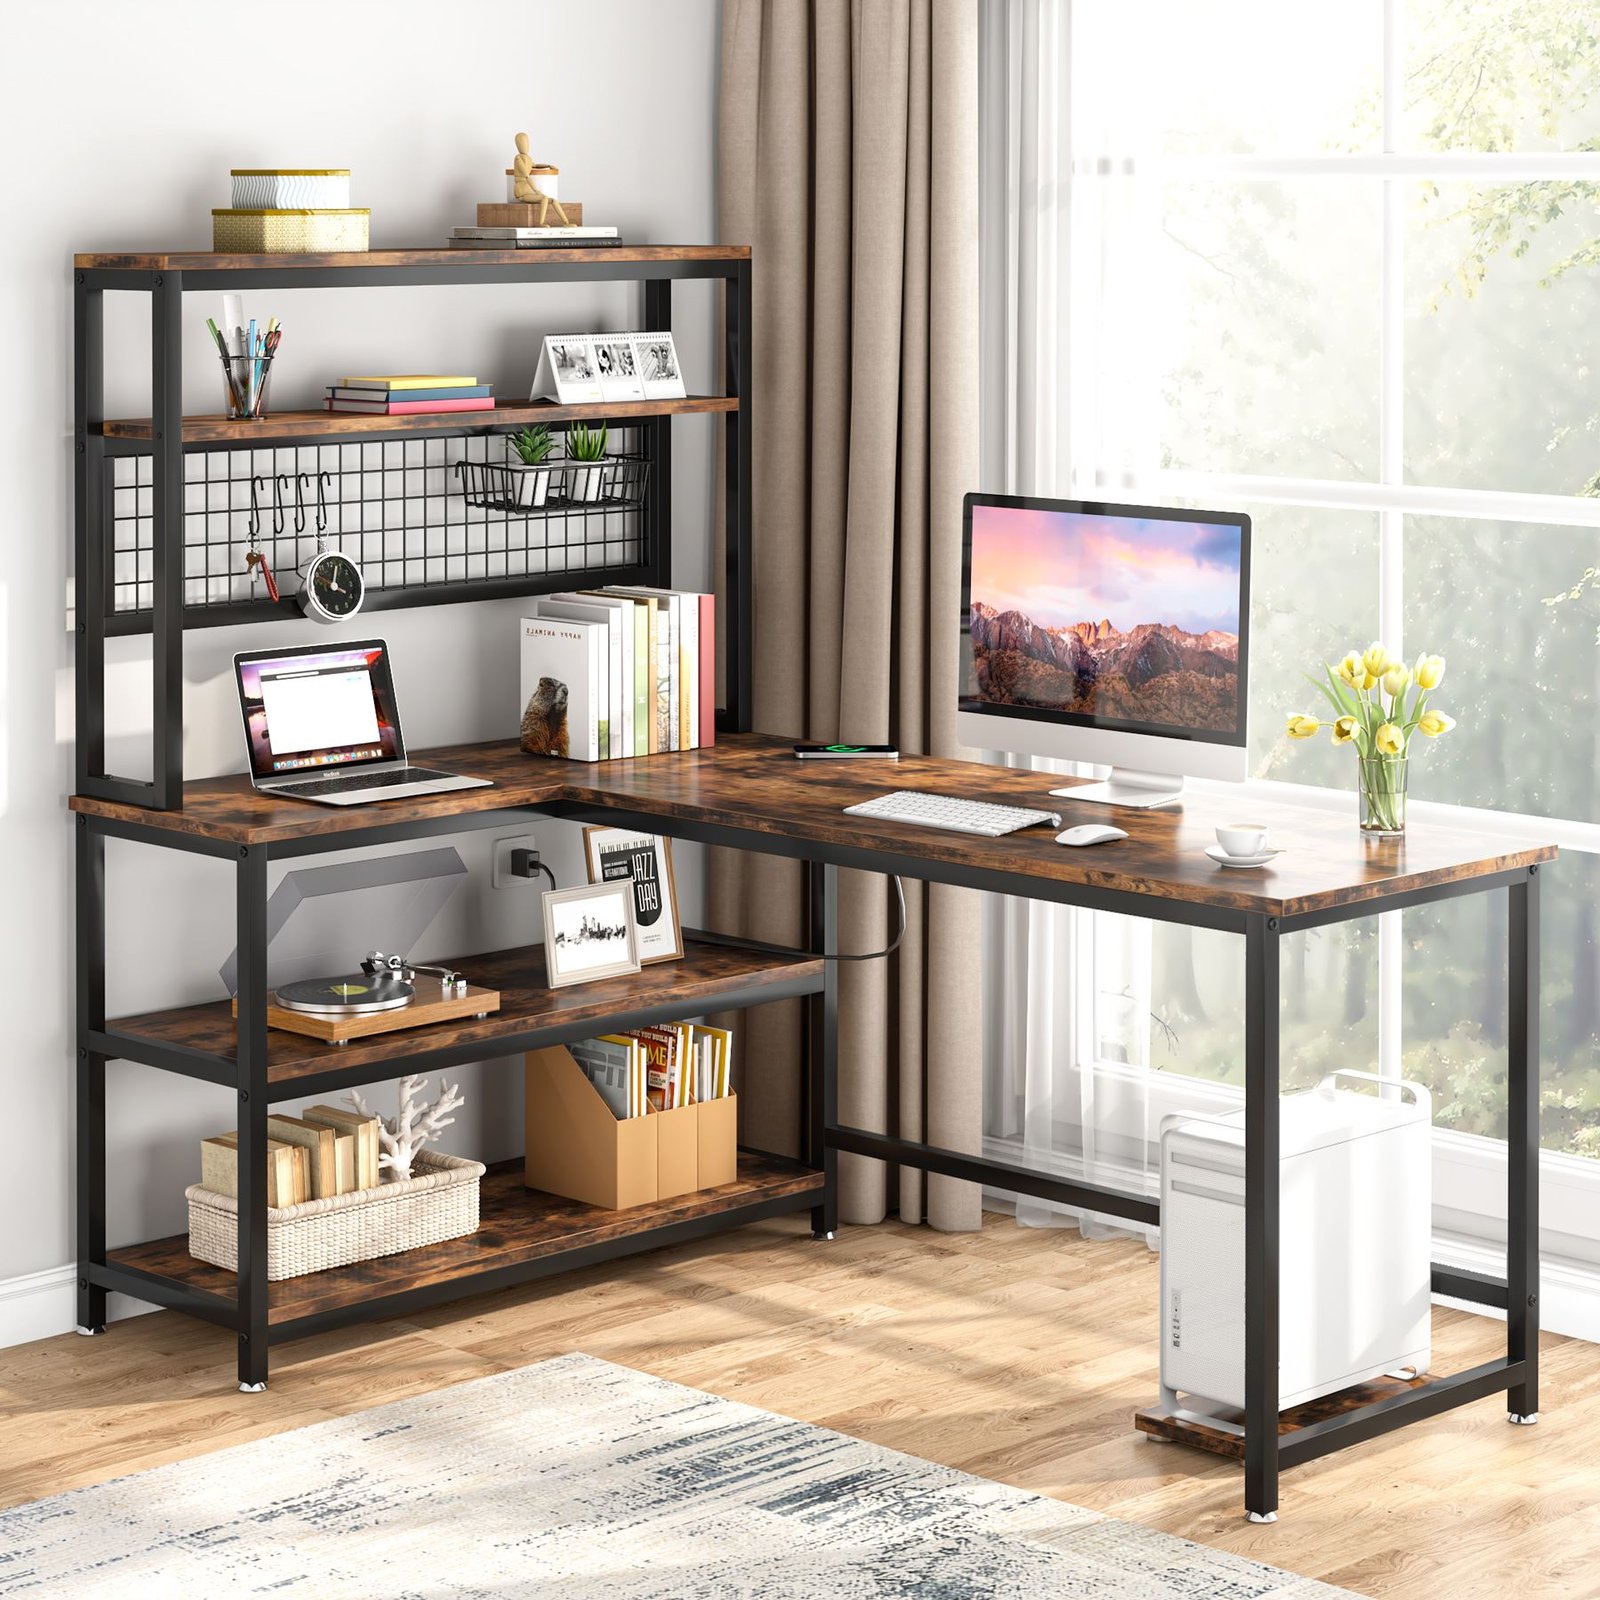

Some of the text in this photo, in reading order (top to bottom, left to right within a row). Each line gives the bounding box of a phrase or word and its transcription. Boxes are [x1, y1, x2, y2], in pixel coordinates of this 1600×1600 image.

[631, 852, 655, 882] JAZZ
[638, 882, 658, 912] DAY
[638, 1042, 667, 1066] OME
